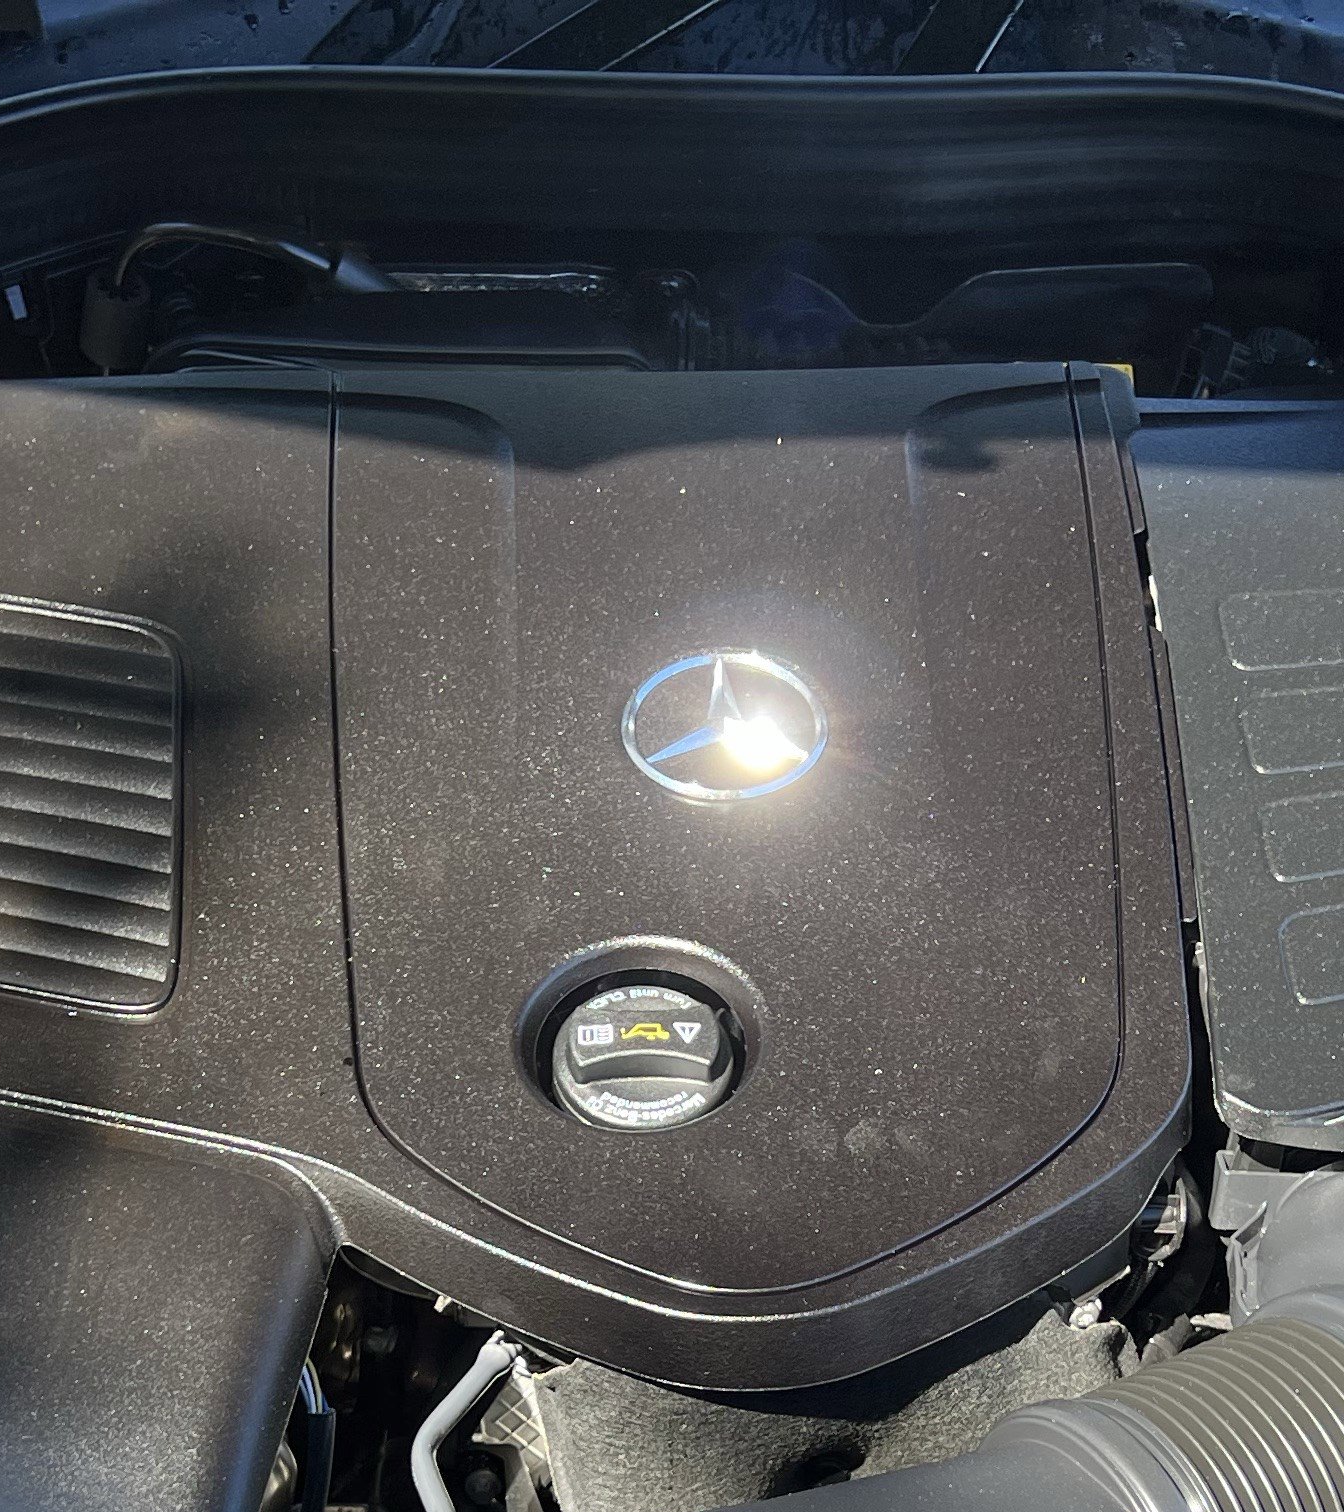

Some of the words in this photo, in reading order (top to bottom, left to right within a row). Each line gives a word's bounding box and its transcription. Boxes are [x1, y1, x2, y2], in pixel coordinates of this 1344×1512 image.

[663, 992, 693, 1010] Turn
[601, 1091, 689, 1109] recommended
[604, 1092, 706, 1123] Mercedes-Benz
